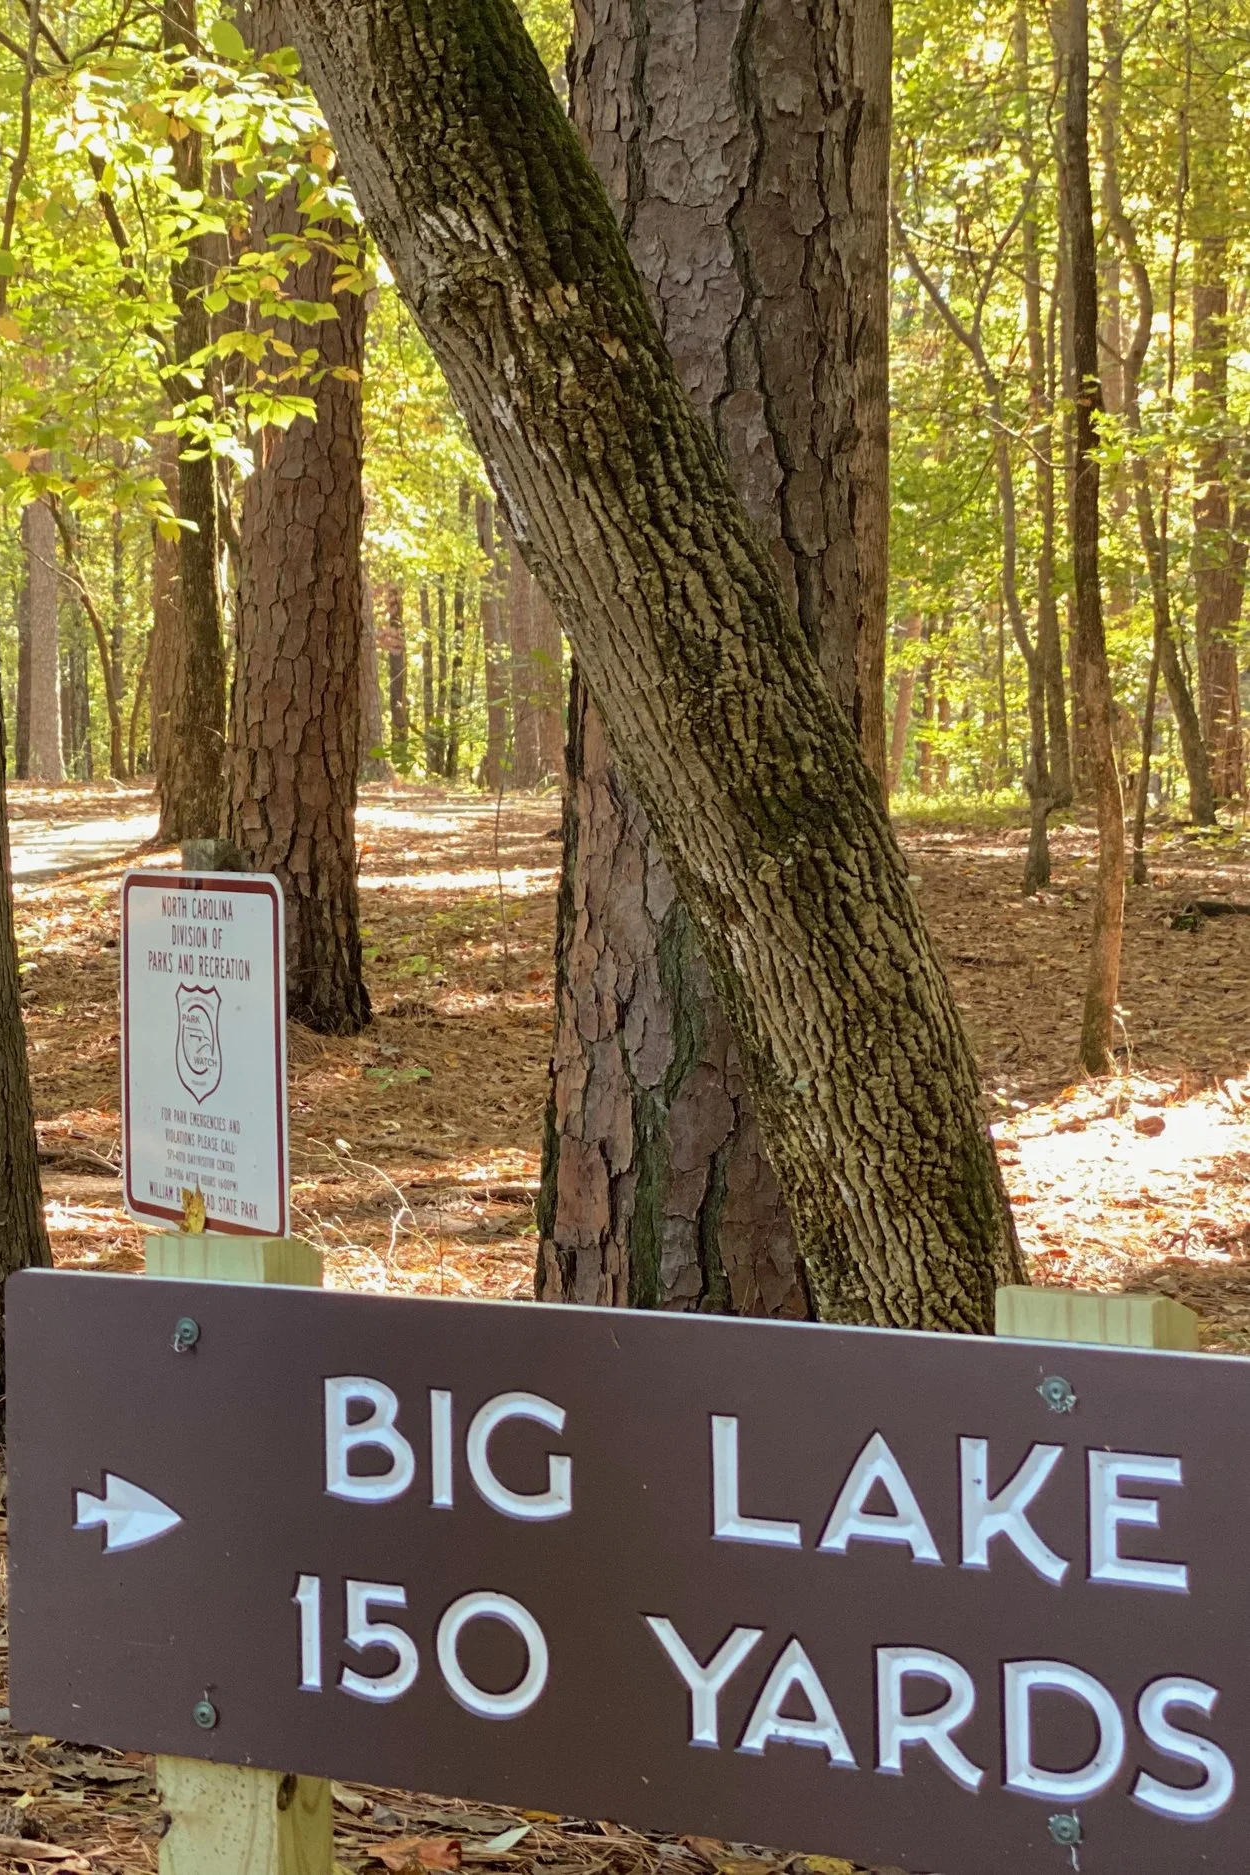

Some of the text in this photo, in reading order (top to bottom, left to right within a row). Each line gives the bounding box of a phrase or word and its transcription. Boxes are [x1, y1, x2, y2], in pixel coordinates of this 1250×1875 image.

[161, 895, 234, 922] NORTH CAROLINA
[171, 924, 223, 950] DIVISION OF
[148, 950, 251, 982] PARKS AND RECREATION
[182, 1014, 201, 1025] PARK
[193, 1056, 218, 1068] WATCH
[161, 1106, 241, 1135] FOR PARK EMERGENCIES AND
[165, 1128, 195, 1147] VIOLATIONS
[197, 1134, 219, 1152] PLEASE
[149, 1180, 174, 1201] WILLIAM
[218, 1196, 238, 1217] STATE
[241, 1201, 259, 1222] PARK
[322, 1373, 1191, 1594] BIG LAKE
[291, 1572, 1237, 1824] 150 YARDS
